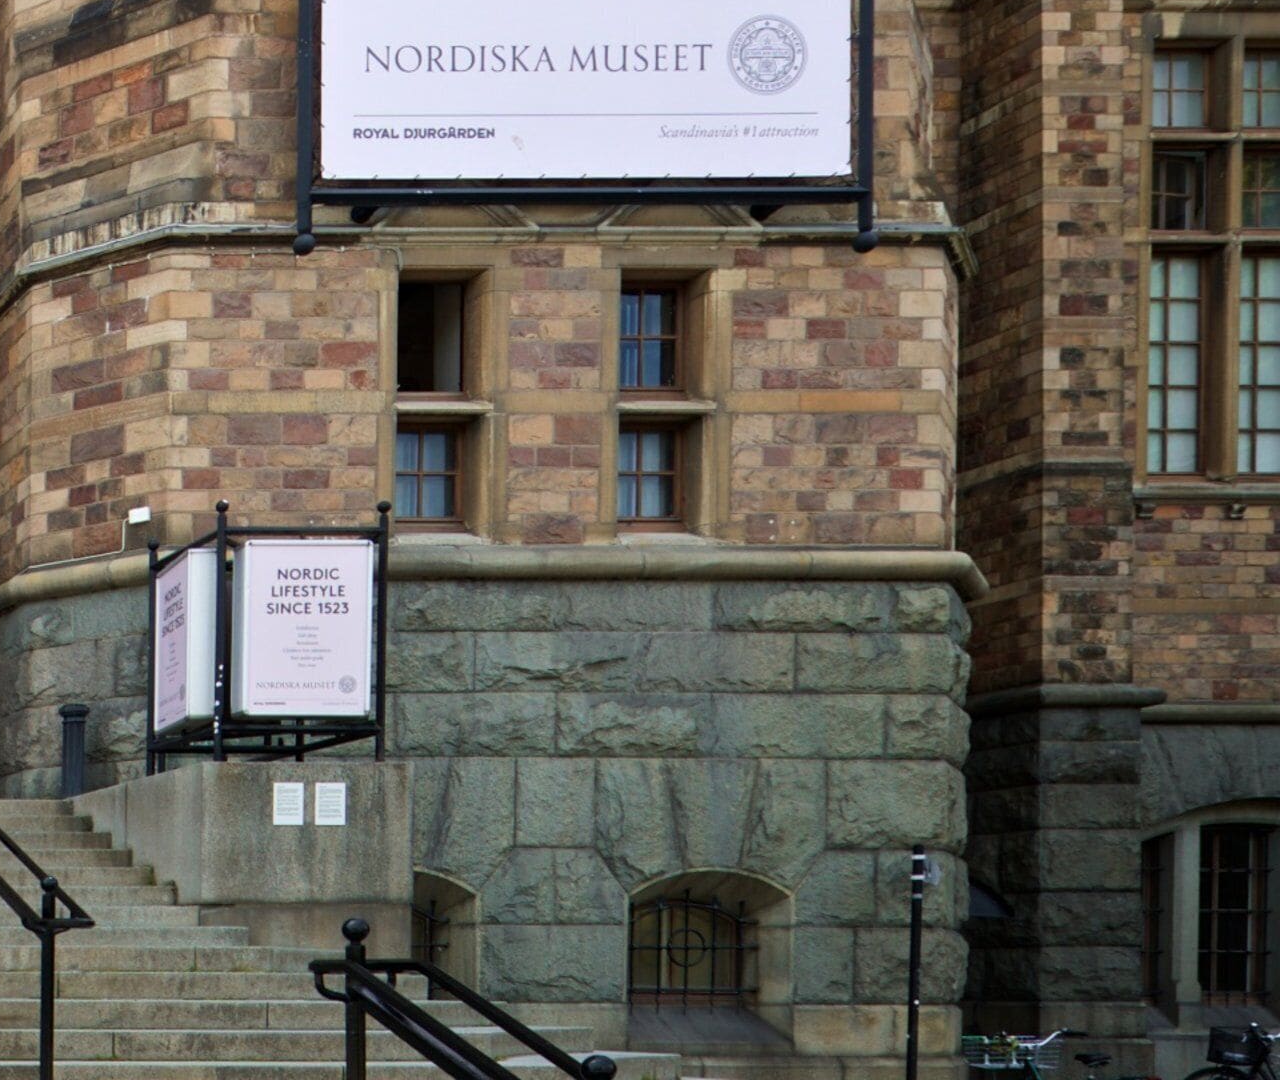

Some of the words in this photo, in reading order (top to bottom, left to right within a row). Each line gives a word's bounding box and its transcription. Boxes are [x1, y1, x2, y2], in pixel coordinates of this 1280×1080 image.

[365, 45, 556, 73] NORDISKA
[568, 43, 713, 73] MUSEET
[352, 127, 400, 140] ROYAL
[403, 126, 496, 140] DJURGÅRDEN
[277, 567, 340, 581] NORDIC
[271, 584, 345, 598] LIFESTYLE
[266, 602, 312, 615] SINCE
[317, 601, 350, 615] 1523
